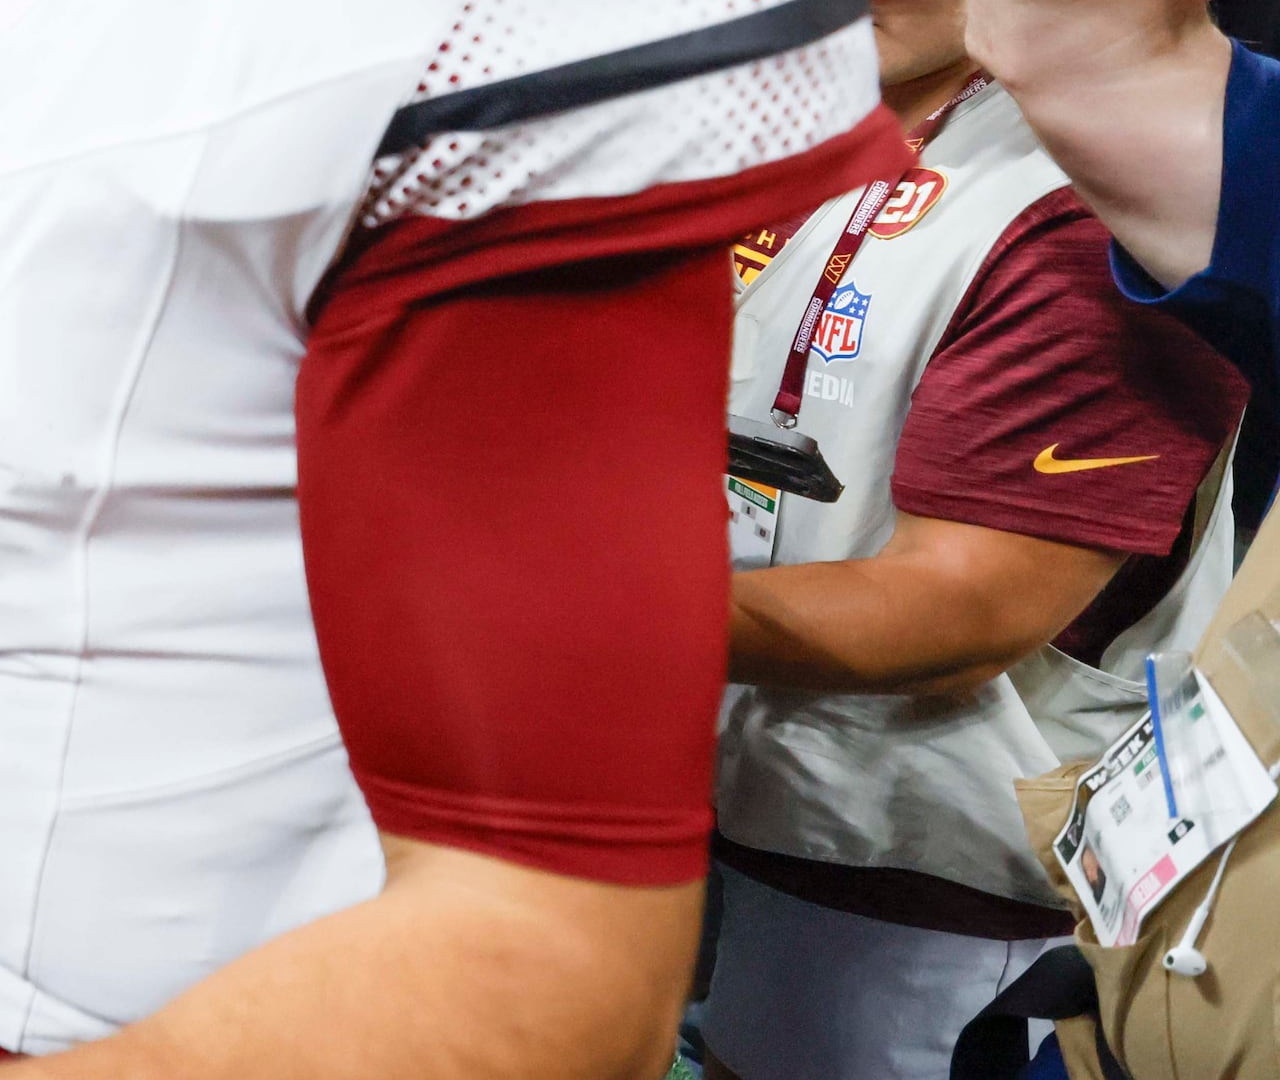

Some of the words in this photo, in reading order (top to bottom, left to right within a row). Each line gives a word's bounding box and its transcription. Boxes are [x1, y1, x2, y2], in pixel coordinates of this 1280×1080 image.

[874, 181, 938, 224] 21
[812, 313, 856, 353] NFL
[804, 370, 854, 408] EDIA
